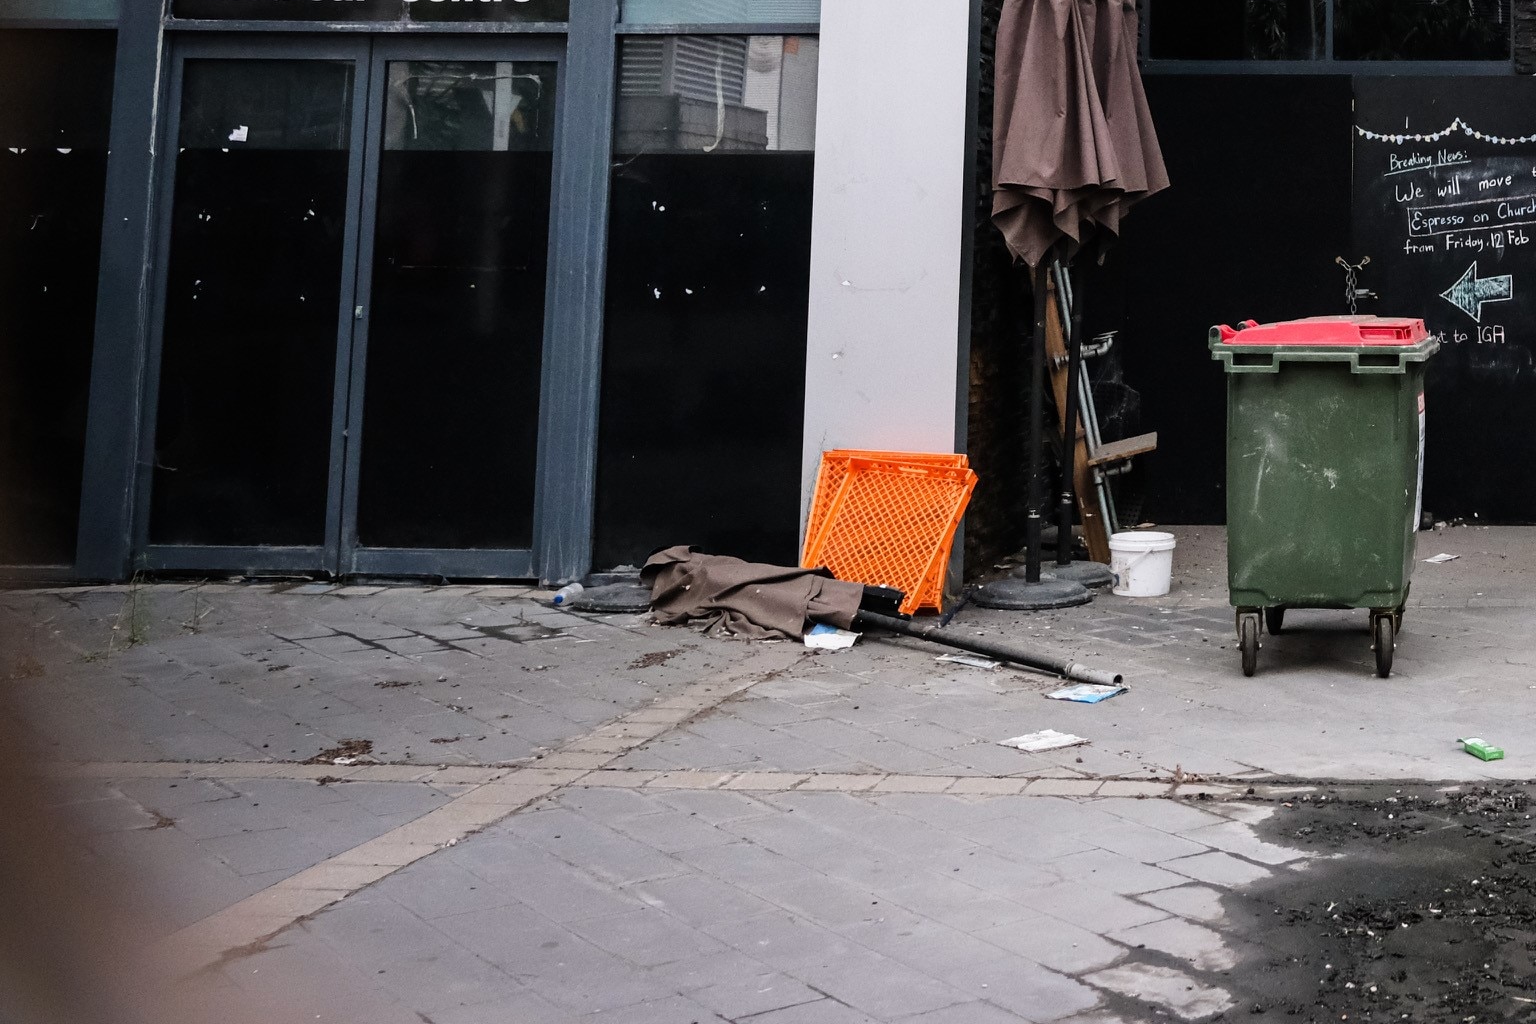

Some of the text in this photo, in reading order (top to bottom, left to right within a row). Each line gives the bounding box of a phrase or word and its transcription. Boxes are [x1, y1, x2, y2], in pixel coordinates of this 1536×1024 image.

[1389, 148, 1468, 171] Breaking News:
[1395, 182, 1424, 202] We
[1437, 174, 1461, 197] will
[1478, 175, 1512, 192] move
[1411, 211, 1465, 235] Espresso
[1473, 213, 1490, 223] on
[1403, 239, 1435, 255] from
[1507, 229, 1530, 246] Feb
[1453, 329, 1468, 343] to
[1477, 325, 1506, 344] IGA
